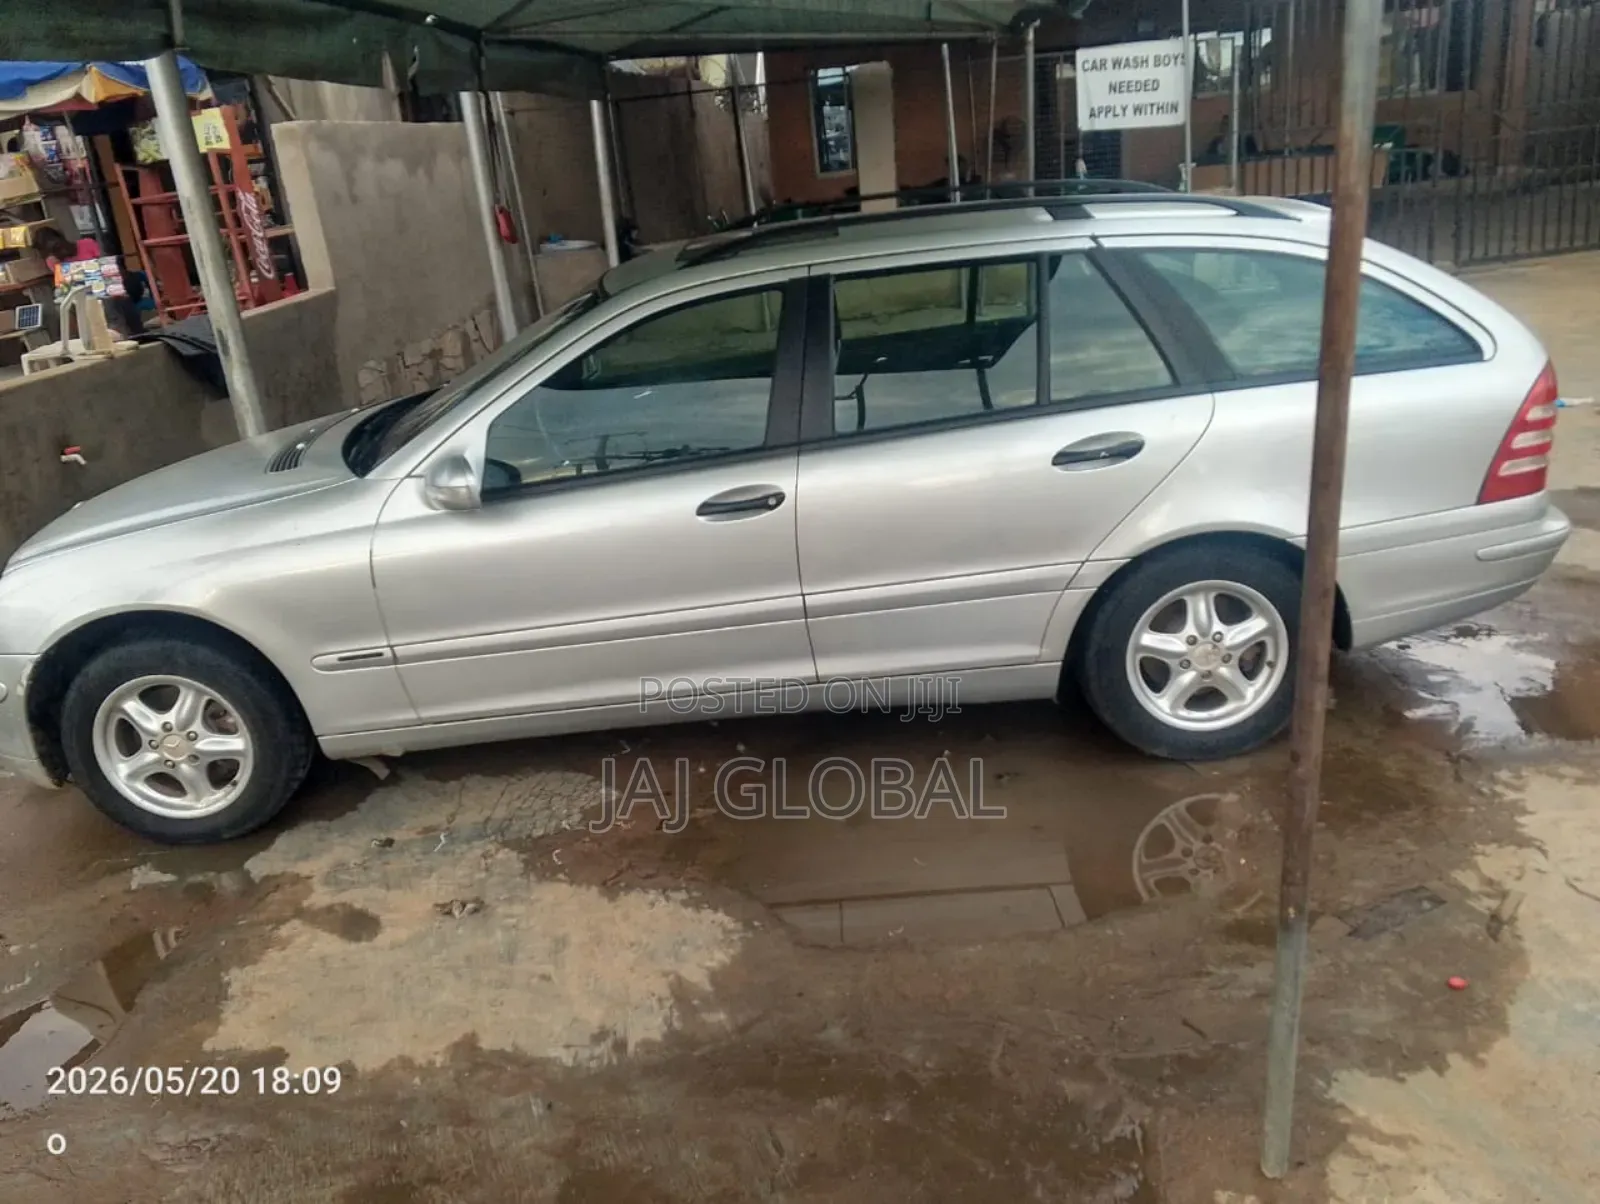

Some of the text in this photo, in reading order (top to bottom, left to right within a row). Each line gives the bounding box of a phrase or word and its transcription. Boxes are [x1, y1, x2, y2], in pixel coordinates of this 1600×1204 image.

[1082, 59, 1108, 72] CAR
[1111, 56, 1149, 70] WASH
[1108, 79, 1160, 95] NEEDED
[1089, 101, 1179, 120] APPLY WITHIN
